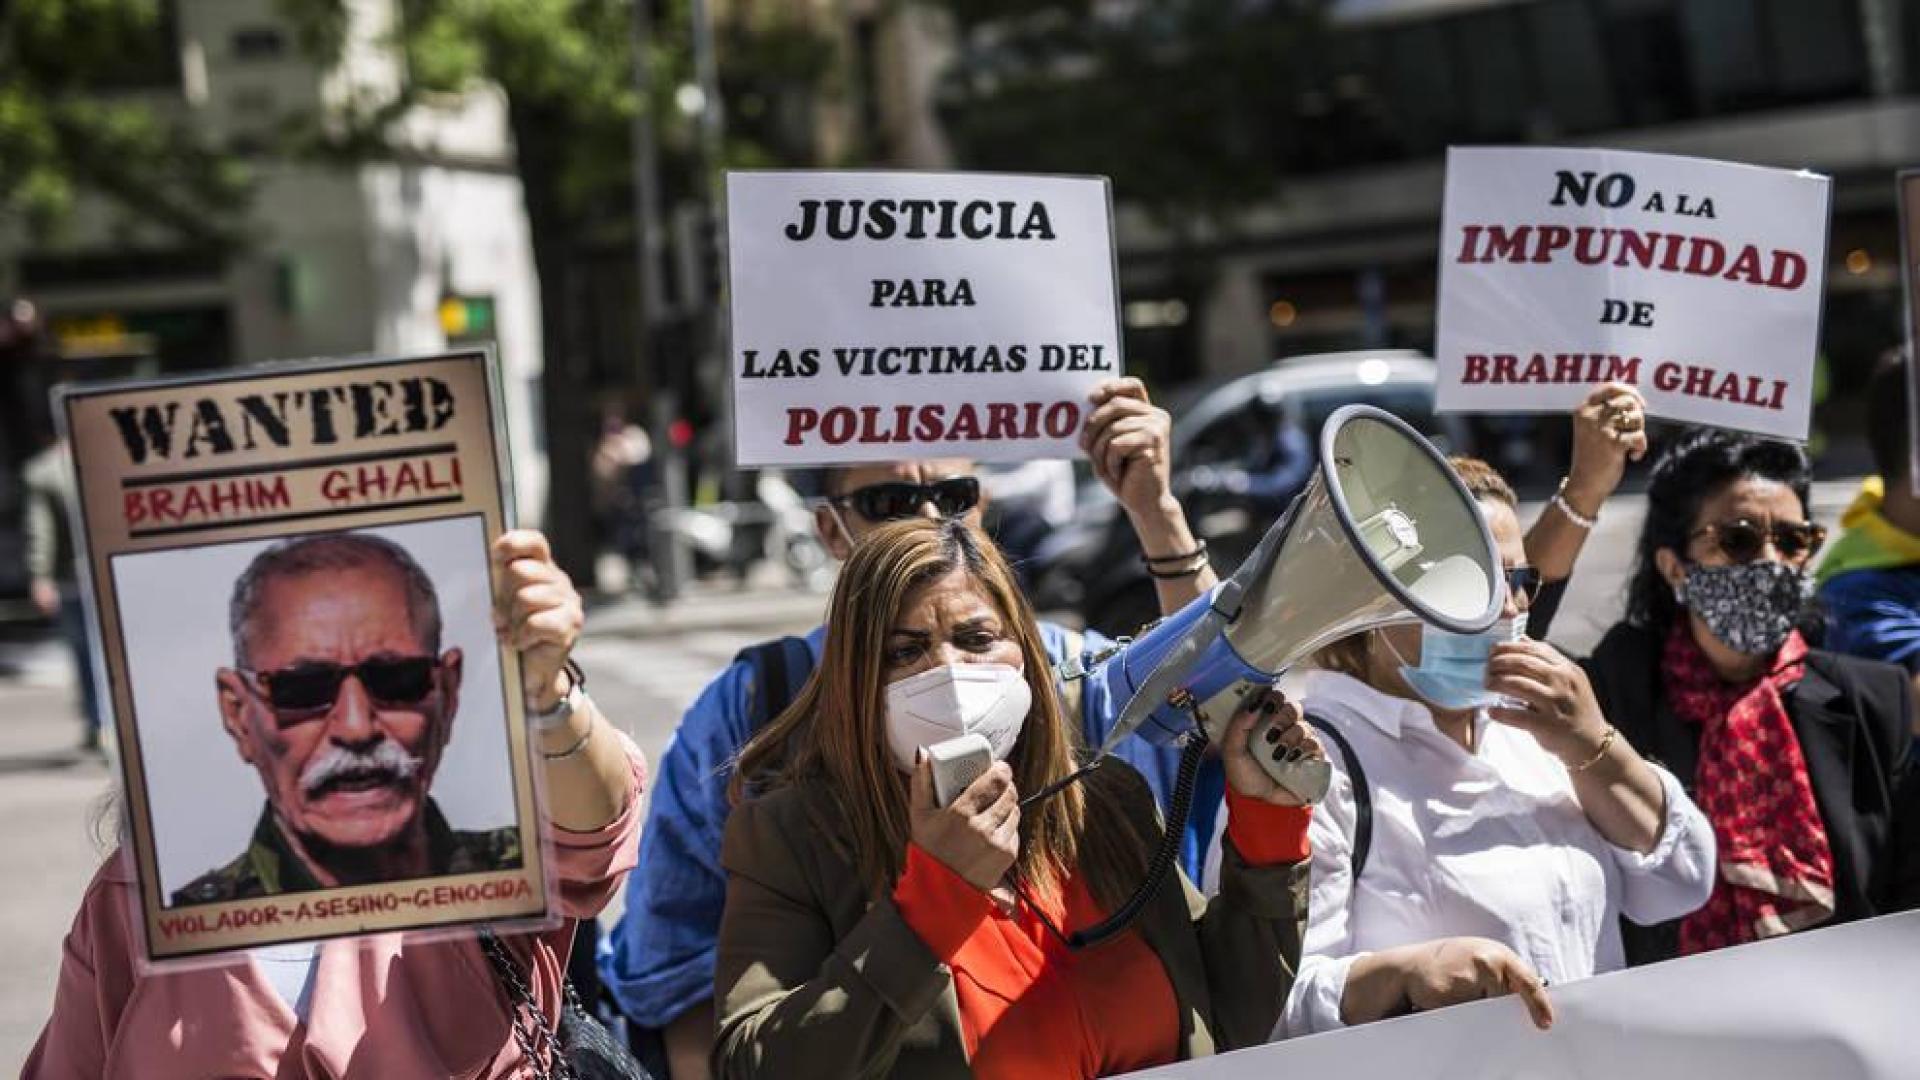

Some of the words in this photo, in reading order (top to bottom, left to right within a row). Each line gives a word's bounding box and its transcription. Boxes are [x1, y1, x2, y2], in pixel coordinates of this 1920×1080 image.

[1550, 170, 1636, 208] NO
[1643, 192, 1666, 212] A
[1675, 195, 1716, 218] LA
[785, 200, 1056, 241] JUSTICIA
[1456, 224, 1808, 290] IMPUNIDAD
[869, 278, 976, 307] PARA
[1600, 299, 1655, 328] DE
[741, 350, 820, 378] LAS
[833, 345, 1027, 375] VICTIMAS
[1039, 344, 1112, 371] DEL
[1462, 354, 1642, 385] BRAHIM
[1653, 362, 1788, 410] GHALI
[109, 376, 455, 463] WANTED
[783, 401, 1079, 447] POLISARIO
[123, 475, 291, 524] BRAHIM
[320, 457, 464, 504] GHALI
